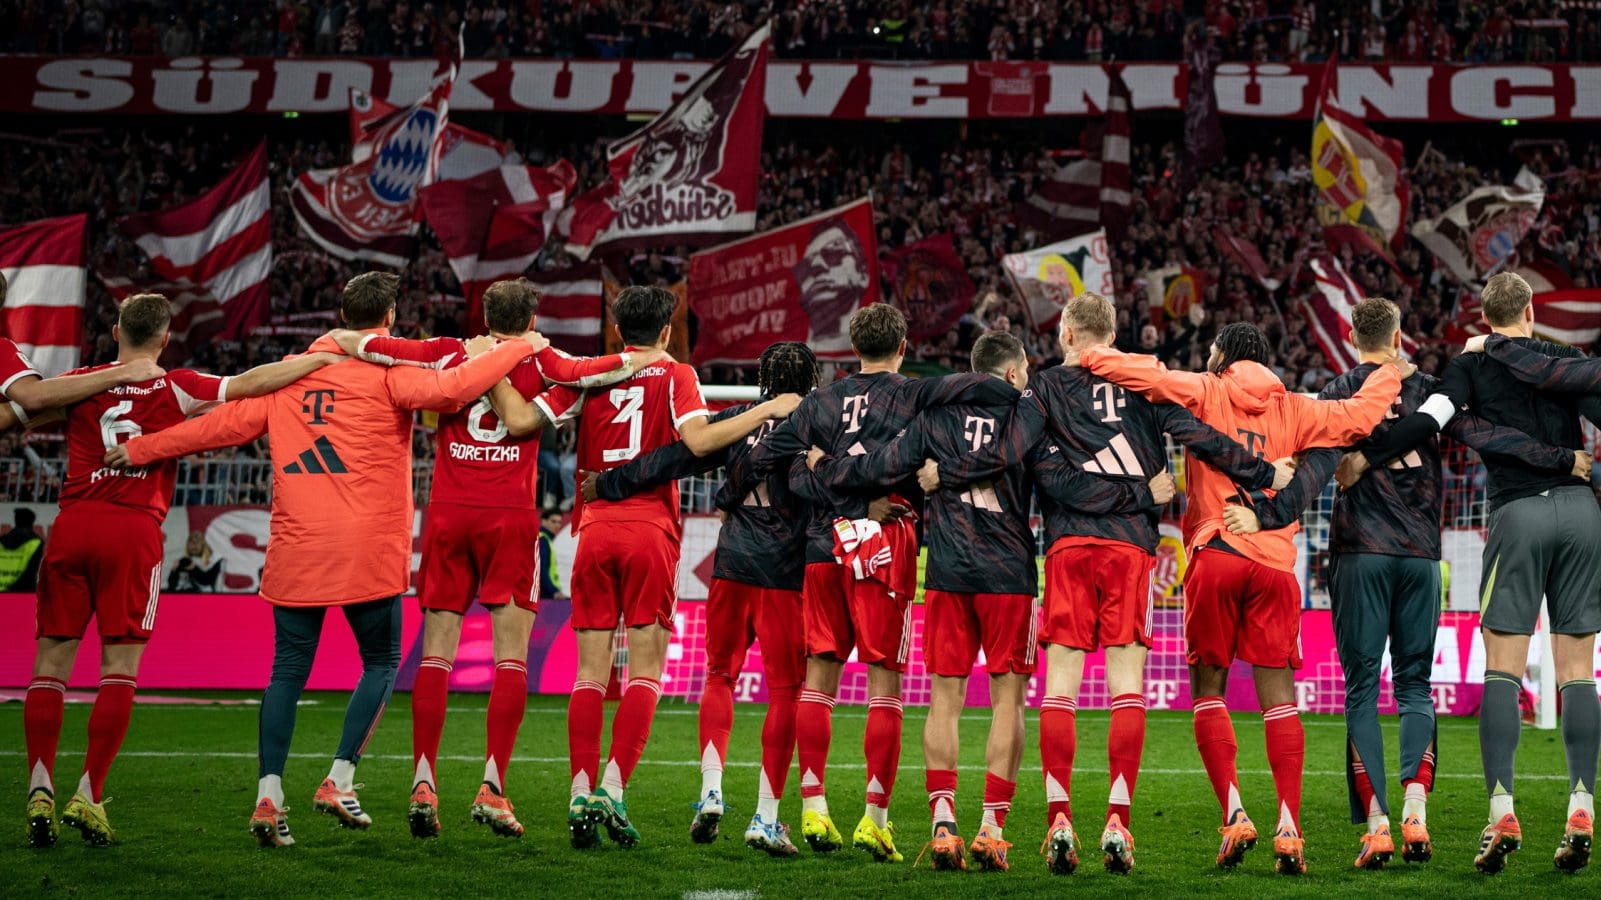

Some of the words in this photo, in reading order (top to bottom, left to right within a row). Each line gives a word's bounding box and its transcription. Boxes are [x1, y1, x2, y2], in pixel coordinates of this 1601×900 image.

[100, 400, 142, 452] 6
[603, 386, 645, 462] 3
[449, 442, 520, 462] GORETZKA
